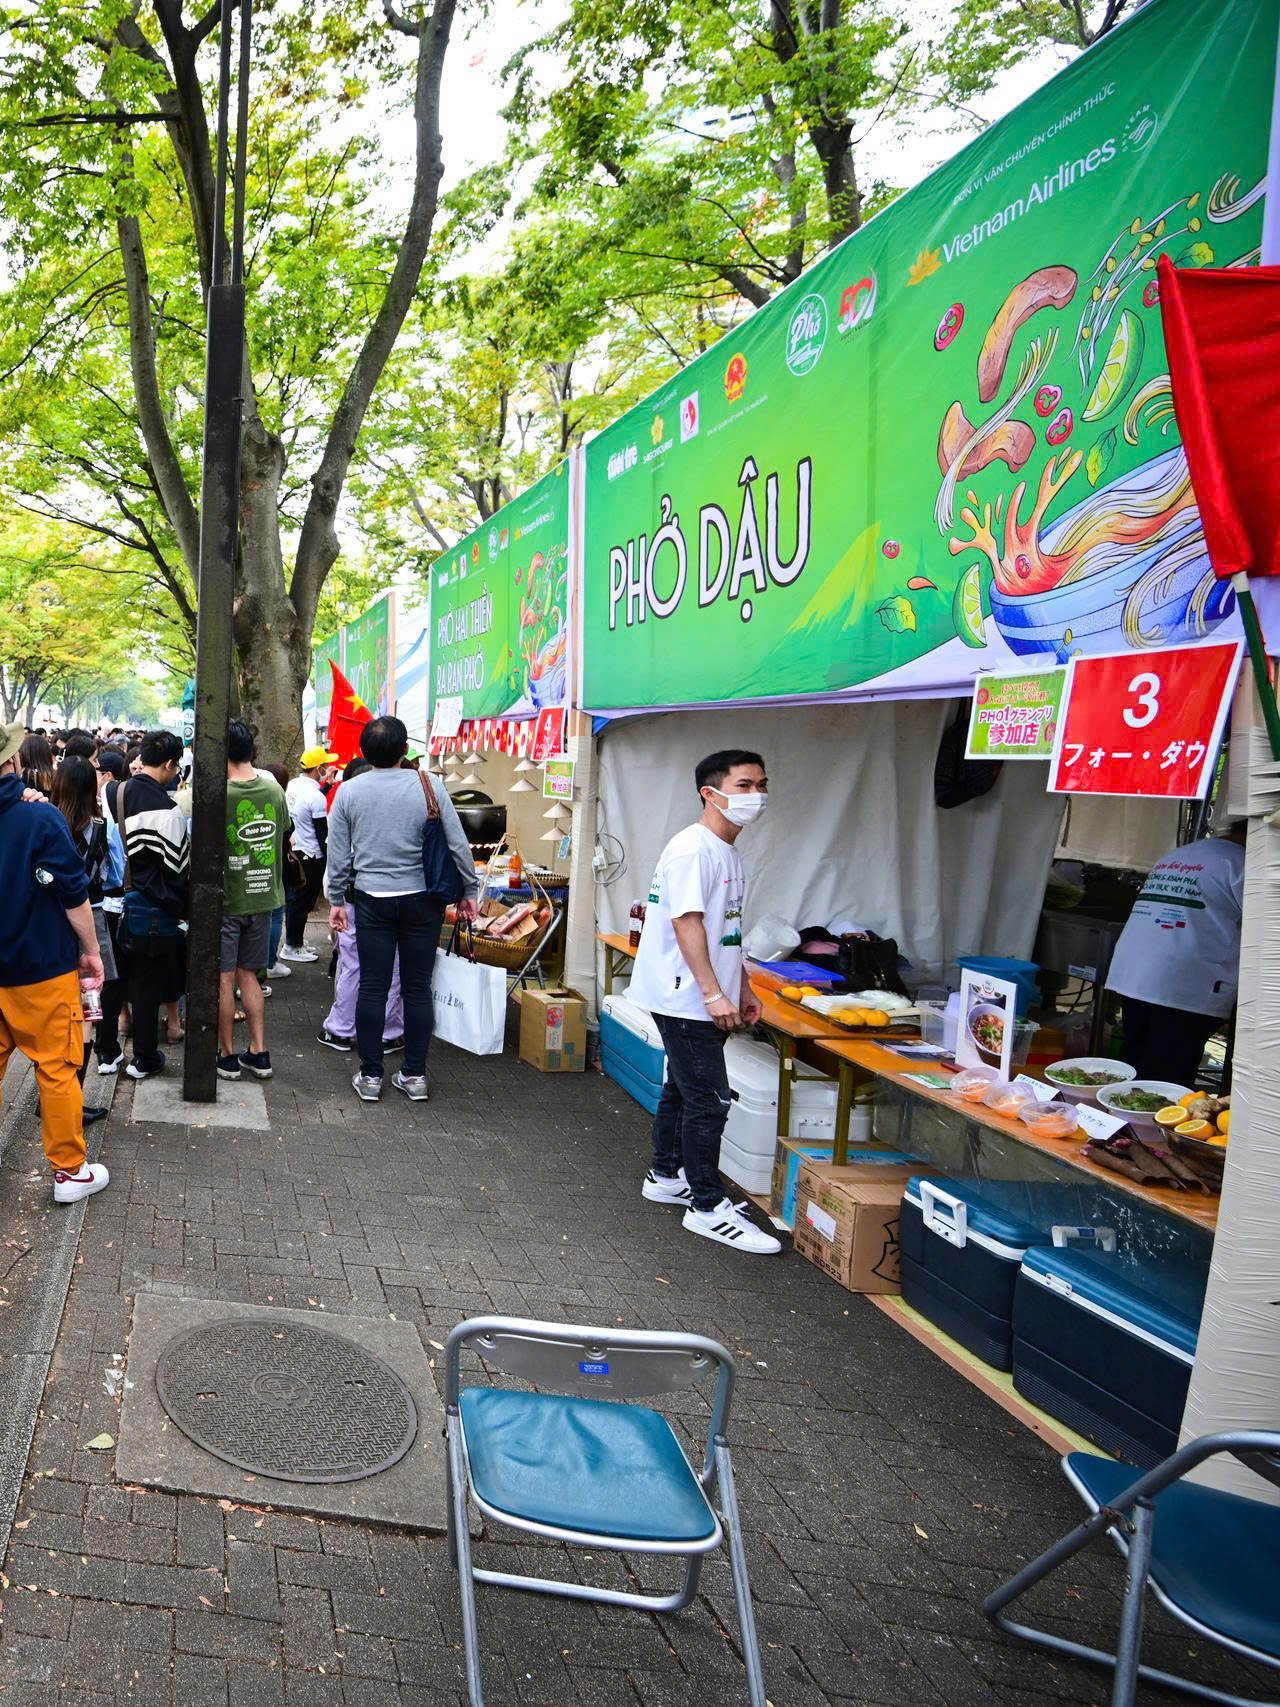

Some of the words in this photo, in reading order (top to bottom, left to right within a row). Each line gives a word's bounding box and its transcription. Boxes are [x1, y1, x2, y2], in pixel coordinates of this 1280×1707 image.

[942, 198, 1024, 264] Vietnam
[1024, 137, 1117, 213] Airlines
[609, 493, 687, 631] PHỞ
[698, 455, 812, 624] DẬU
[437, 601, 455, 649] PHỞ
[464, 641, 485, 691] PHỞ
[544, 714, 553, 735] 4
[1123, 672, 1161, 729] 3
[989, 722, 1040, 745] 参加店
[1064, 740, 1206, 770] フォー・ダウ
